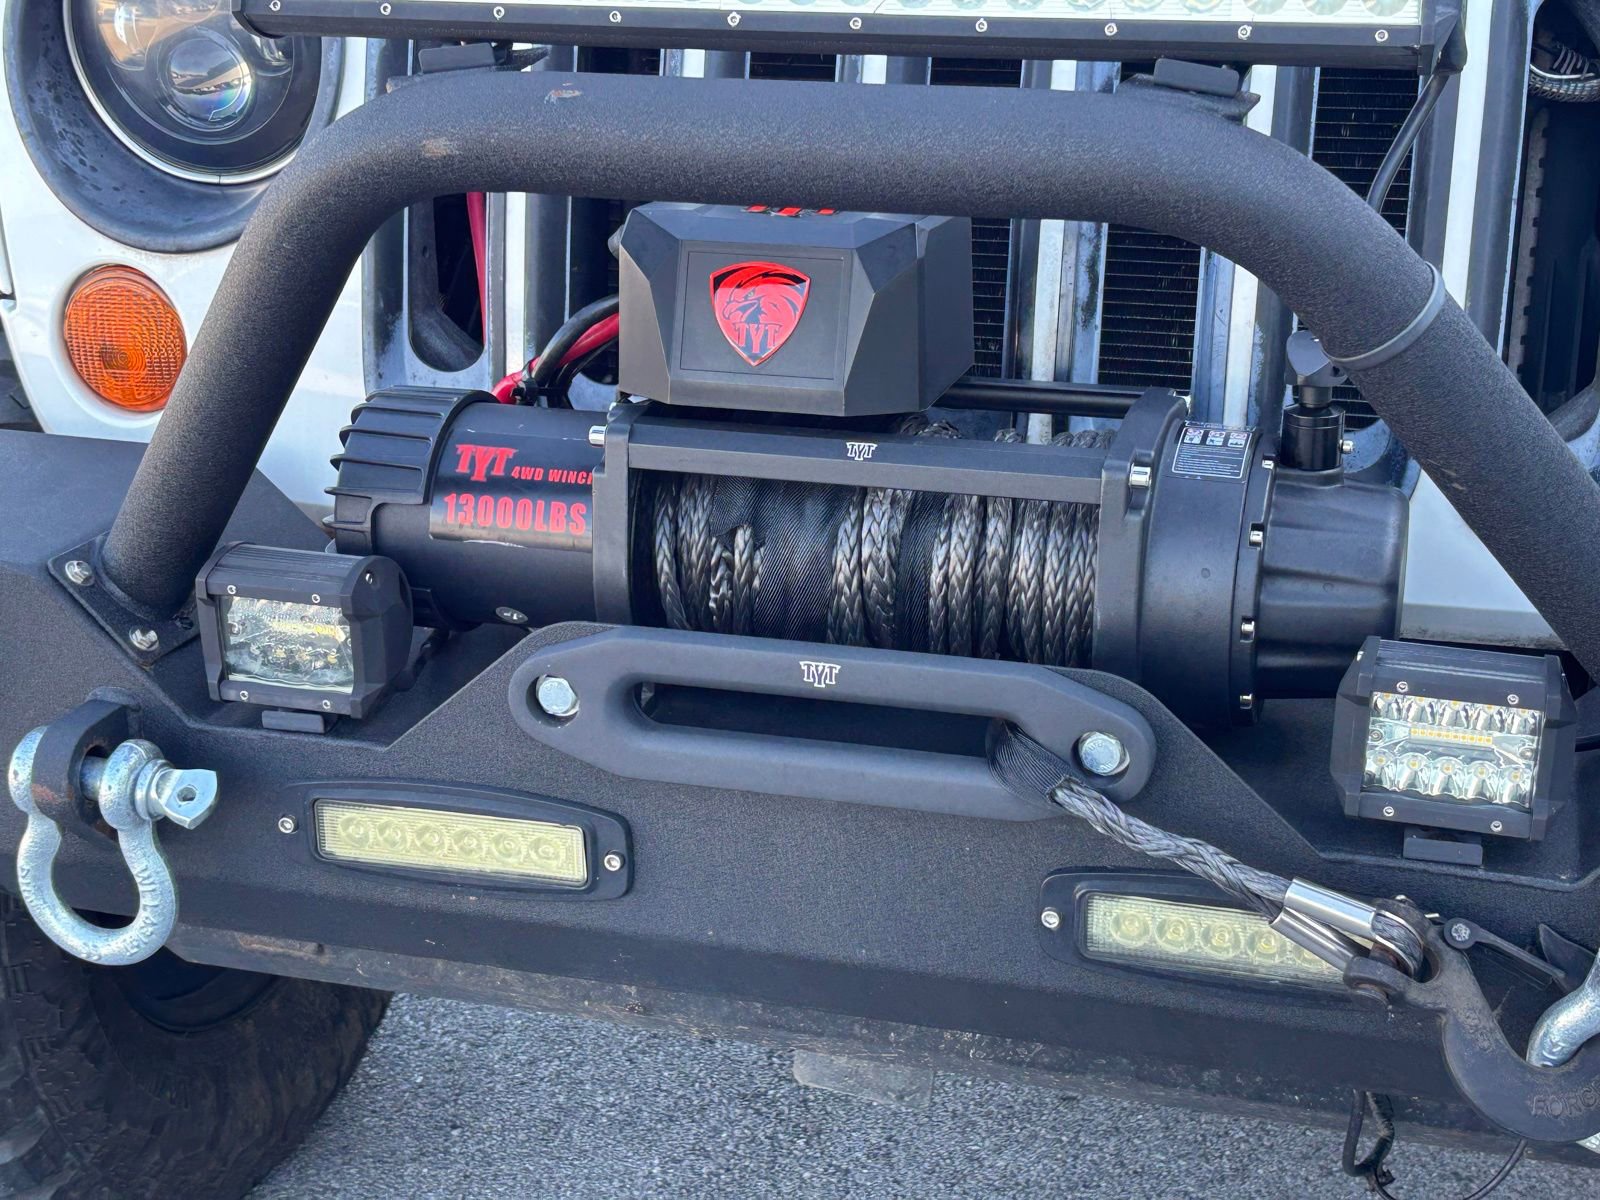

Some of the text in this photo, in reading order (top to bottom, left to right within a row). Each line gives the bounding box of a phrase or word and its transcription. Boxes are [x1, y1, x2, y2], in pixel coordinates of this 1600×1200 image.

[732, 322, 783, 354] TYT
[455, 443, 518, 482] TYT
[511, 465, 544, 481] 4WD
[846, 441, 878, 461] TYT
[443, 492, 587, 536] 13000LBS
[798, 660, 841, 688] TYT
